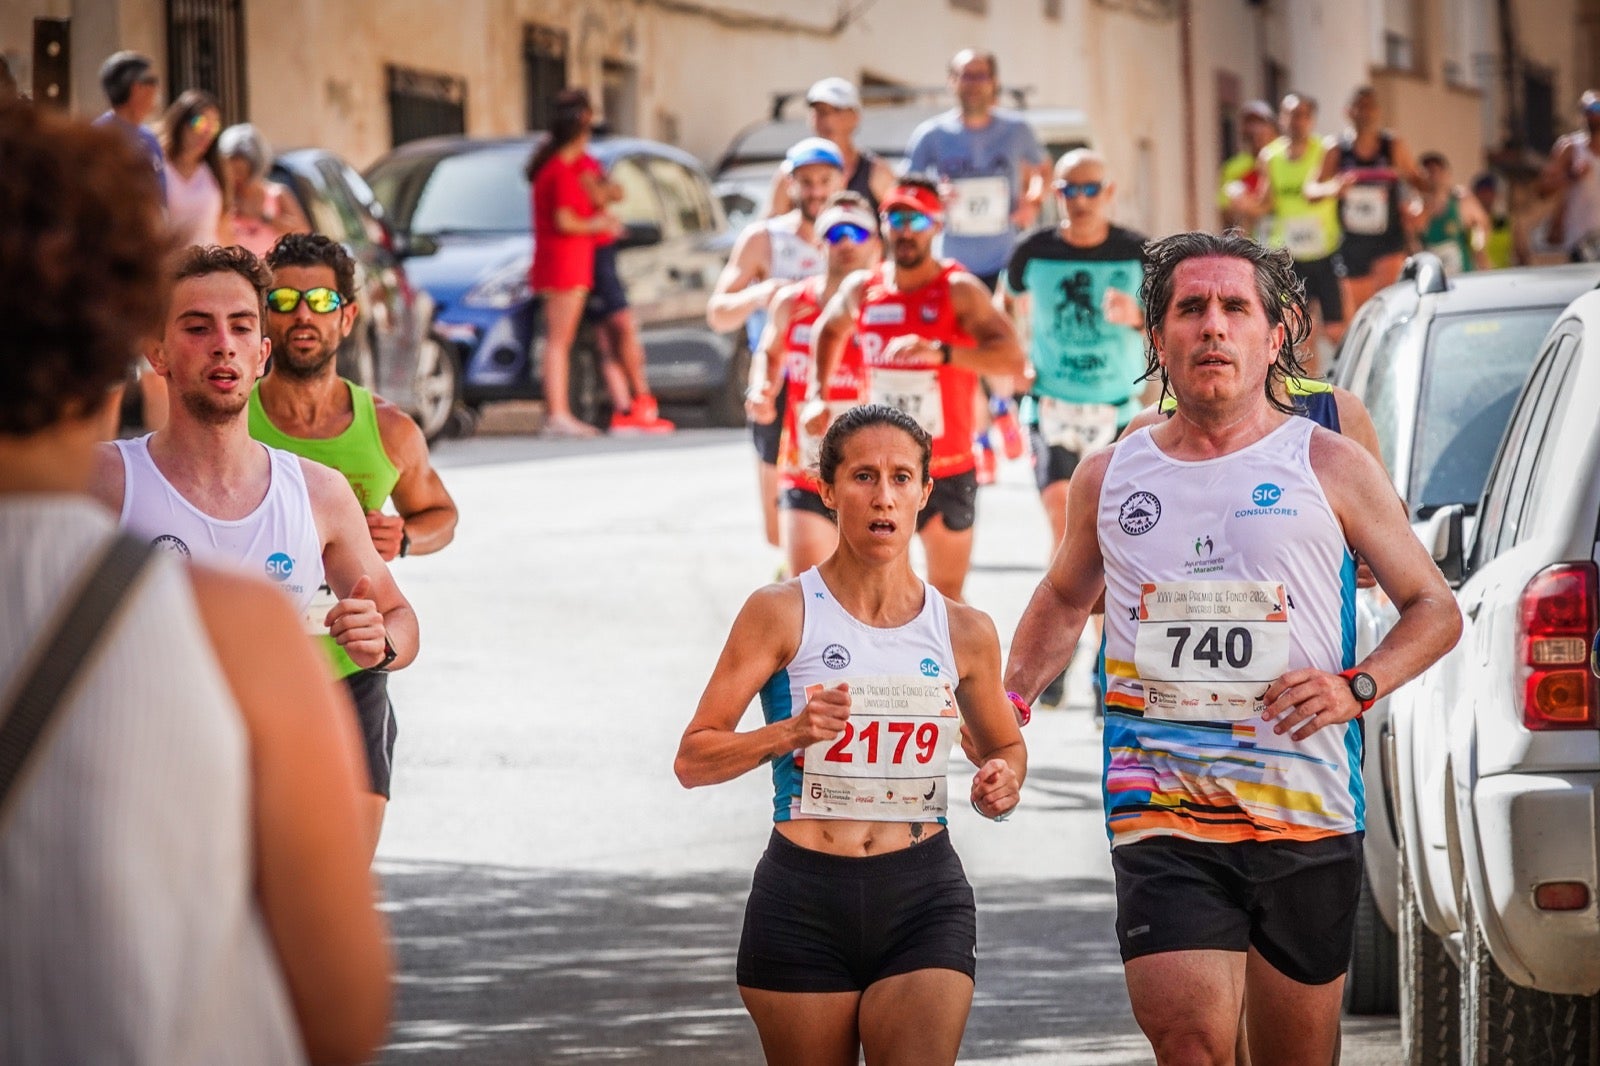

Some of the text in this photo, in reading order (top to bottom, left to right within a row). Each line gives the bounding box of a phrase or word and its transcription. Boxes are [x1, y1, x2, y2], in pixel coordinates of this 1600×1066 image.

[1253, 488, 1280, 501] SIC
[1234, 507, 1298, 518] CONSULTORES
[266, 560, 292, 574] SIC
[1193, 565, 1224, 574] Maracena
[1166, 626, 1253, 669] 740
[921, 663, 940, 674] SIC
[824, 720, 939, 765] 2179
